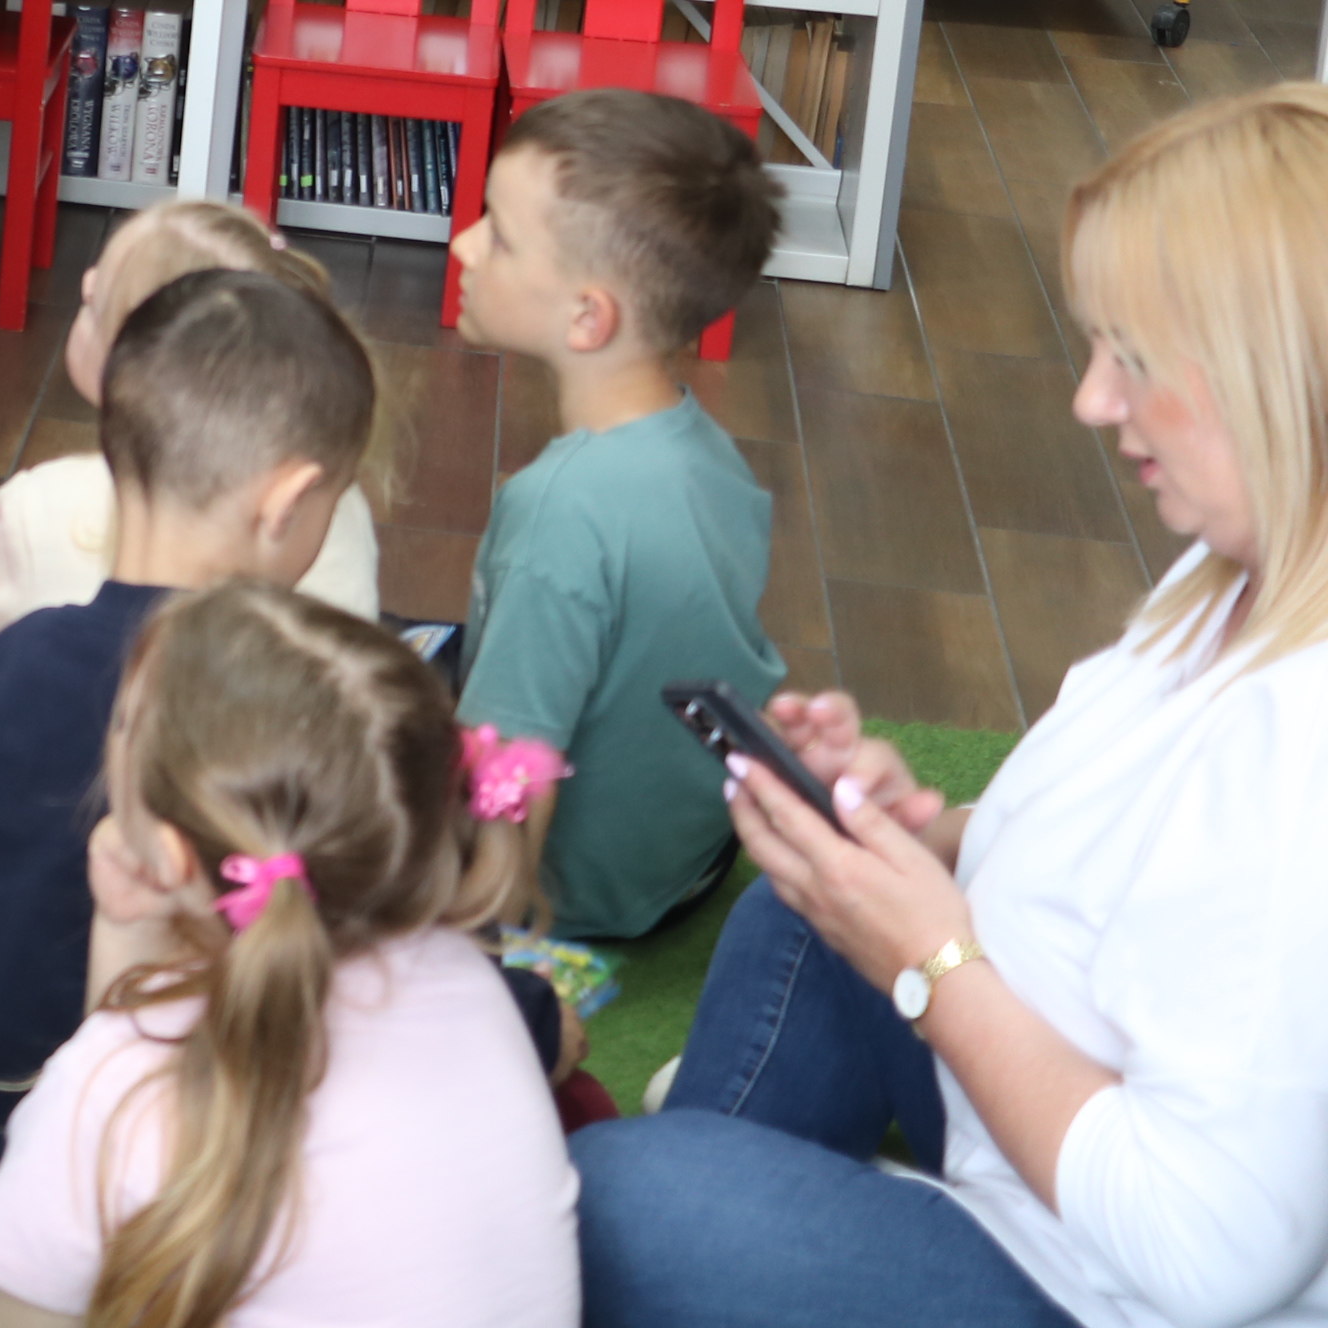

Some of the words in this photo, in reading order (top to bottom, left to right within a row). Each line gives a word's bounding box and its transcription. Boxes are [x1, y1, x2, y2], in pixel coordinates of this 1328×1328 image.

[151, 22, 176, 30] CINDA
[67, 99, 81, 153] KRÓLOWA
[80, 100, 94, 153] WYGNANA
[107, 103, 121, 155] WILKÓW
[144, 102, 158, 165] KORONA
